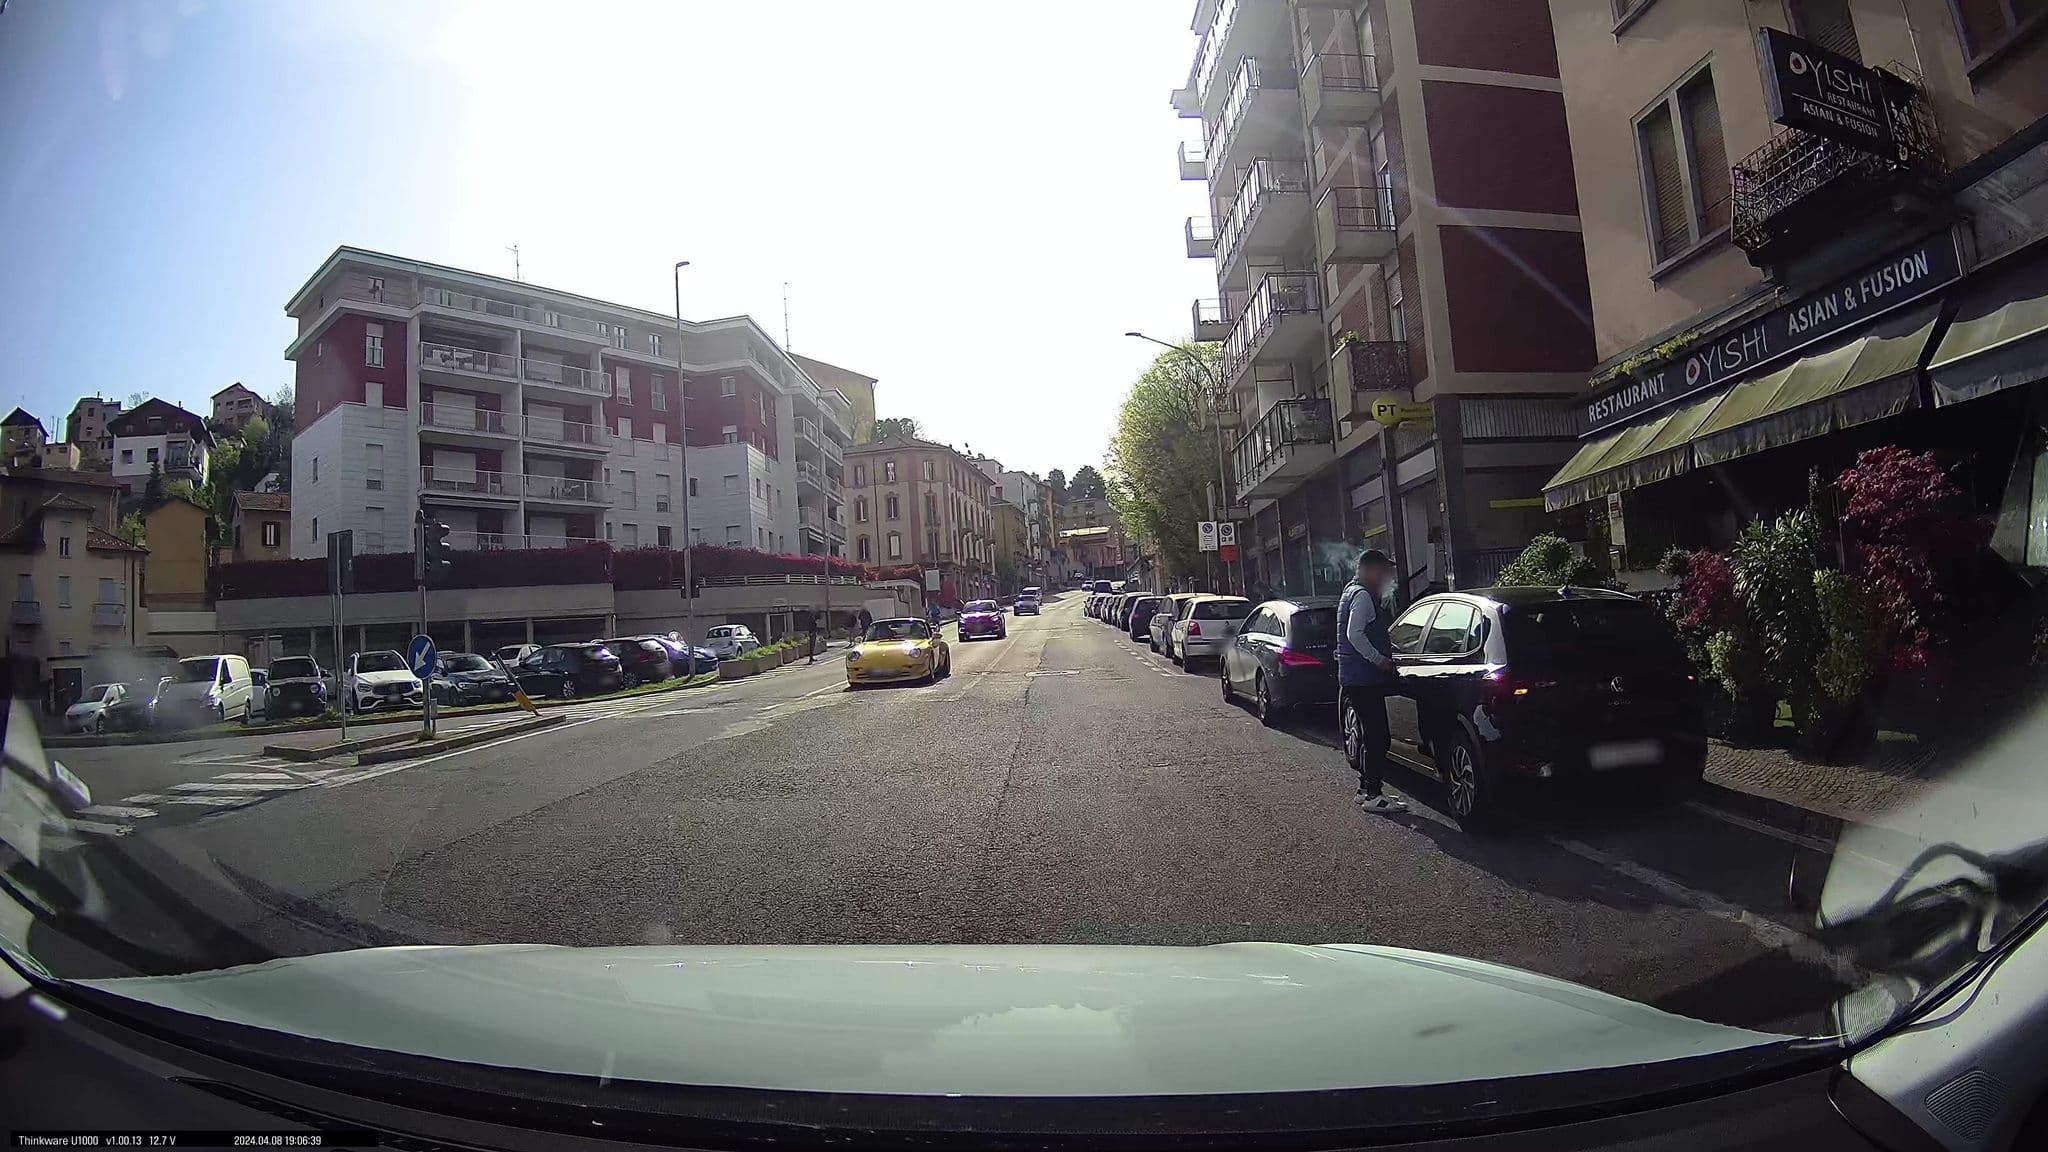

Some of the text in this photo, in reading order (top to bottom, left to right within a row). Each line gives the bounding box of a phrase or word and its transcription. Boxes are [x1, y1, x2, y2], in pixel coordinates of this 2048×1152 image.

[1803, 102, 1879, 138] ASIAN & FUSION
[1827, 92, 1876, 118] RESTAURANT
[1588, 373, 1666, 423] RESTAURANT
[1788, 293, 1839, 337] ASIAN
[1844, 287, 1858, 311] &
[1860, 250, 1929, 303] FUSION
[1377, 404, 1396, 416] PT
